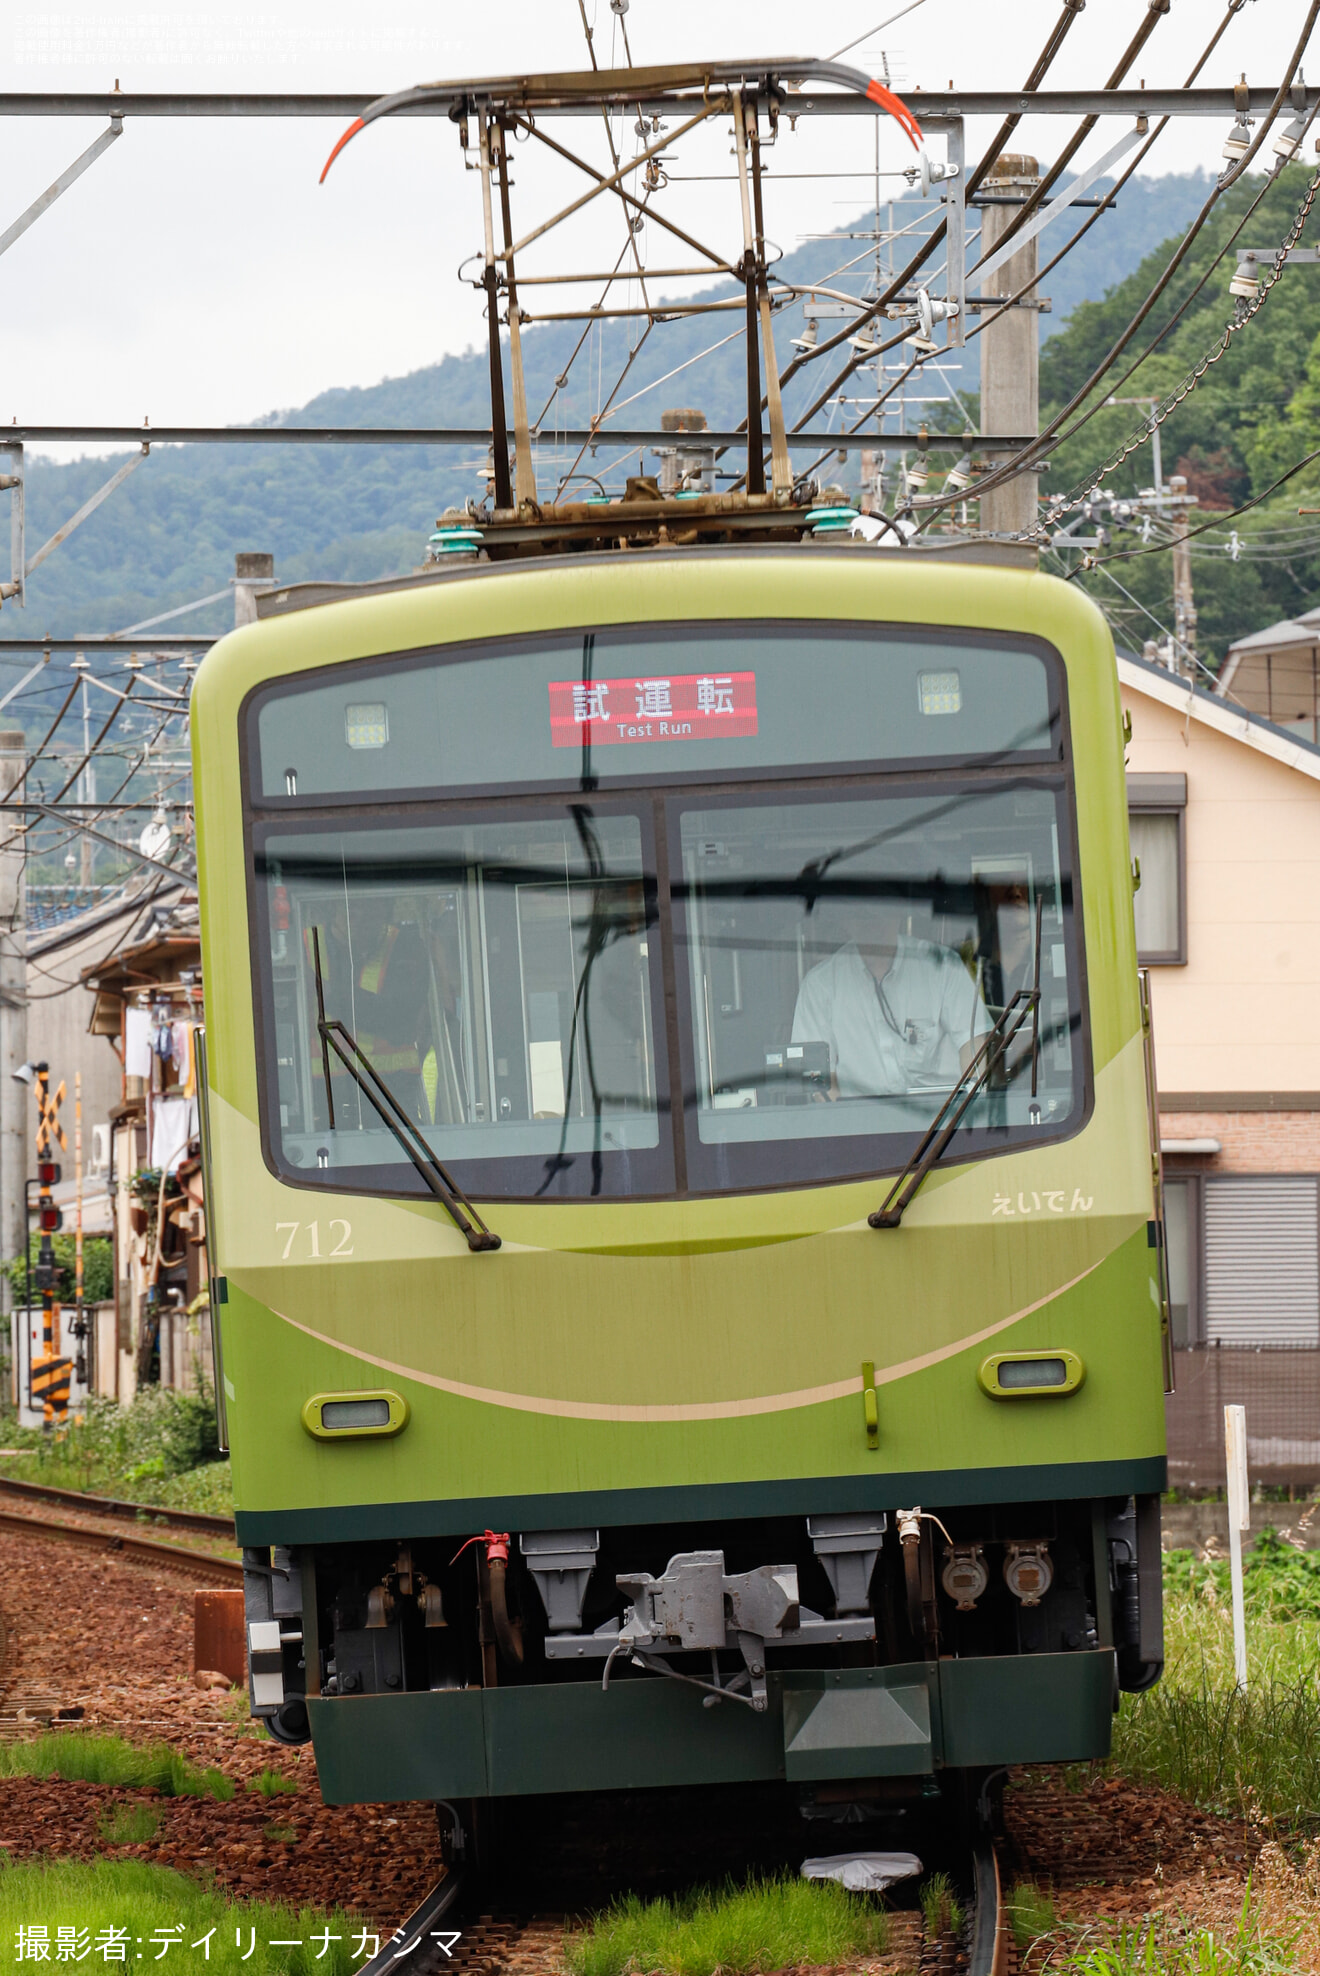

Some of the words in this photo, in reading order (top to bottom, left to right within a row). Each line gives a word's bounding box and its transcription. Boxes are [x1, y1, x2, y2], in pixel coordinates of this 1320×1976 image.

[572, 677, 735, 723] 試運転
[616, 723, 653, 738] Test
[659, 721, 692, 735] Run
[991, 1188, 1094, 1216] えいでん
[275, 1218, 354, 1260] 712
